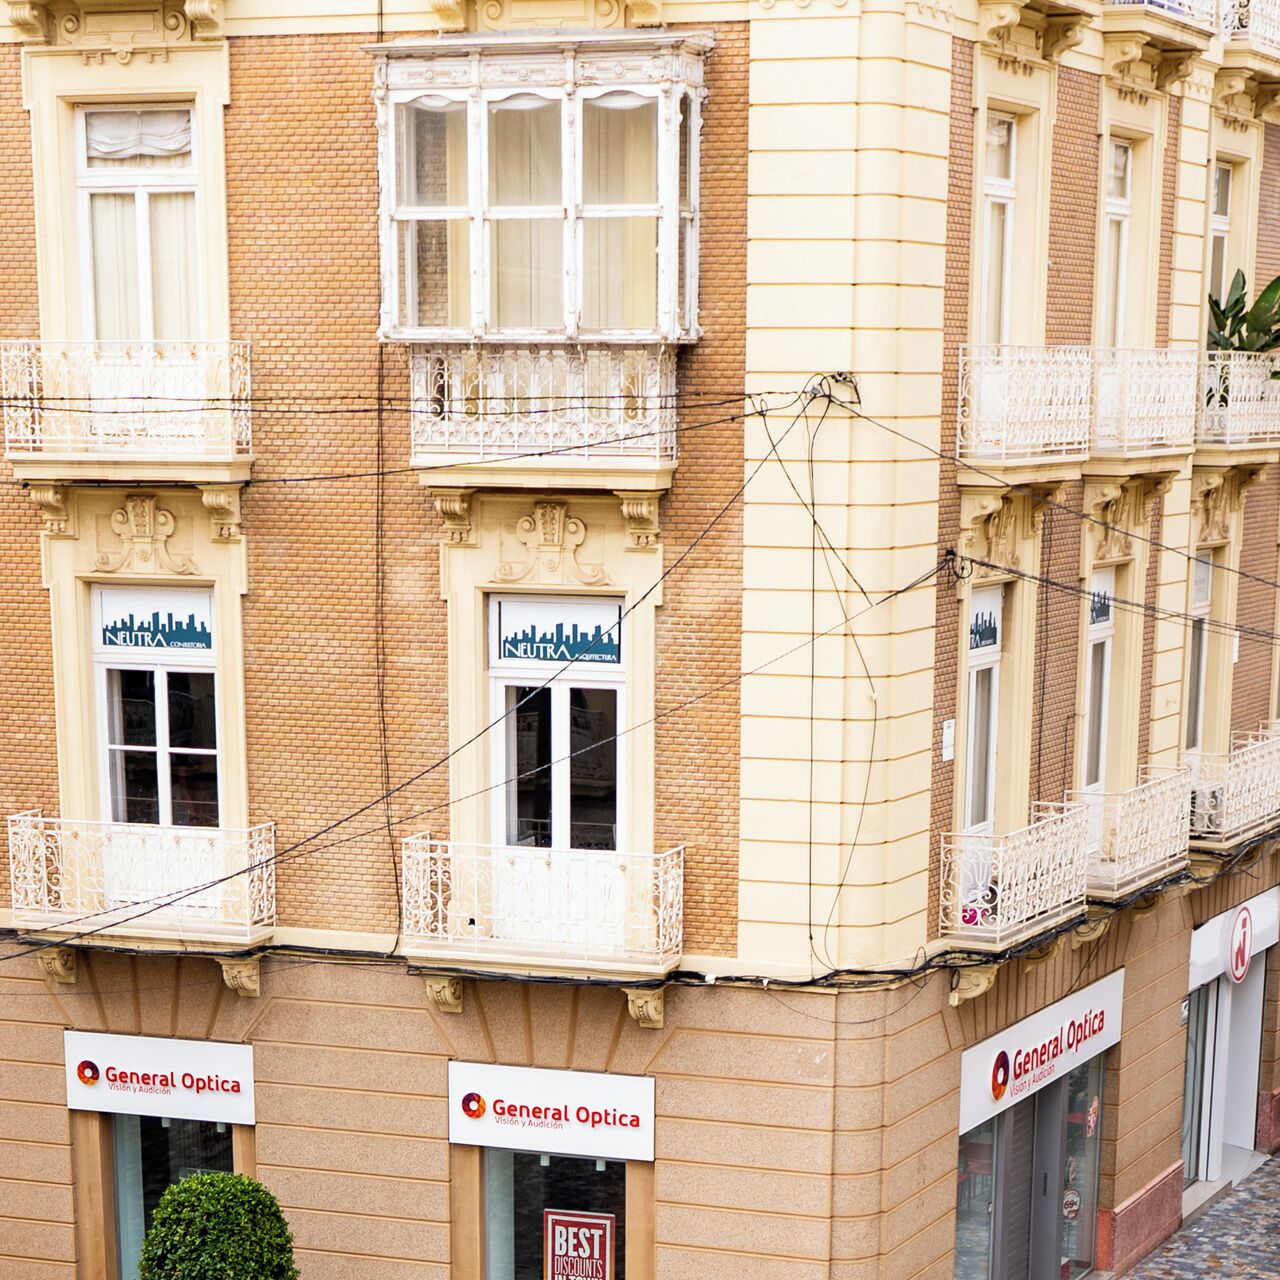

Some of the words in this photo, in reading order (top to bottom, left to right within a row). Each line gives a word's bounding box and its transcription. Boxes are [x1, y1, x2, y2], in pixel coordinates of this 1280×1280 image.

[105, 631, 167, 647] NEUTRA
[505, 642, 571, 659] NEUTRA
[1013, 1027, 1064, 1081] General
[1067, 1009, 1106, 1053] Optica
[105, 1066, 177, 1088] General
[181, 1072, 241, 1094] Optica
[108, 1082, 132, 1092] Visión
[138, 1085, 171, 1095] Audición
[1009, 1079, 1027, 1098] Visión
[1032, 1064, 1055, 1085] Audición
[492, 1099, 570, 1122] General
[576, 1106, 641, 1128] Optica
[495, 1115, 520, 1126] Visión
[527, 1119, 564, 1130] Audición
[554, 1225, 603, 1259] BEST
[554, 1256, 603, 1278] DISCOUNTS
